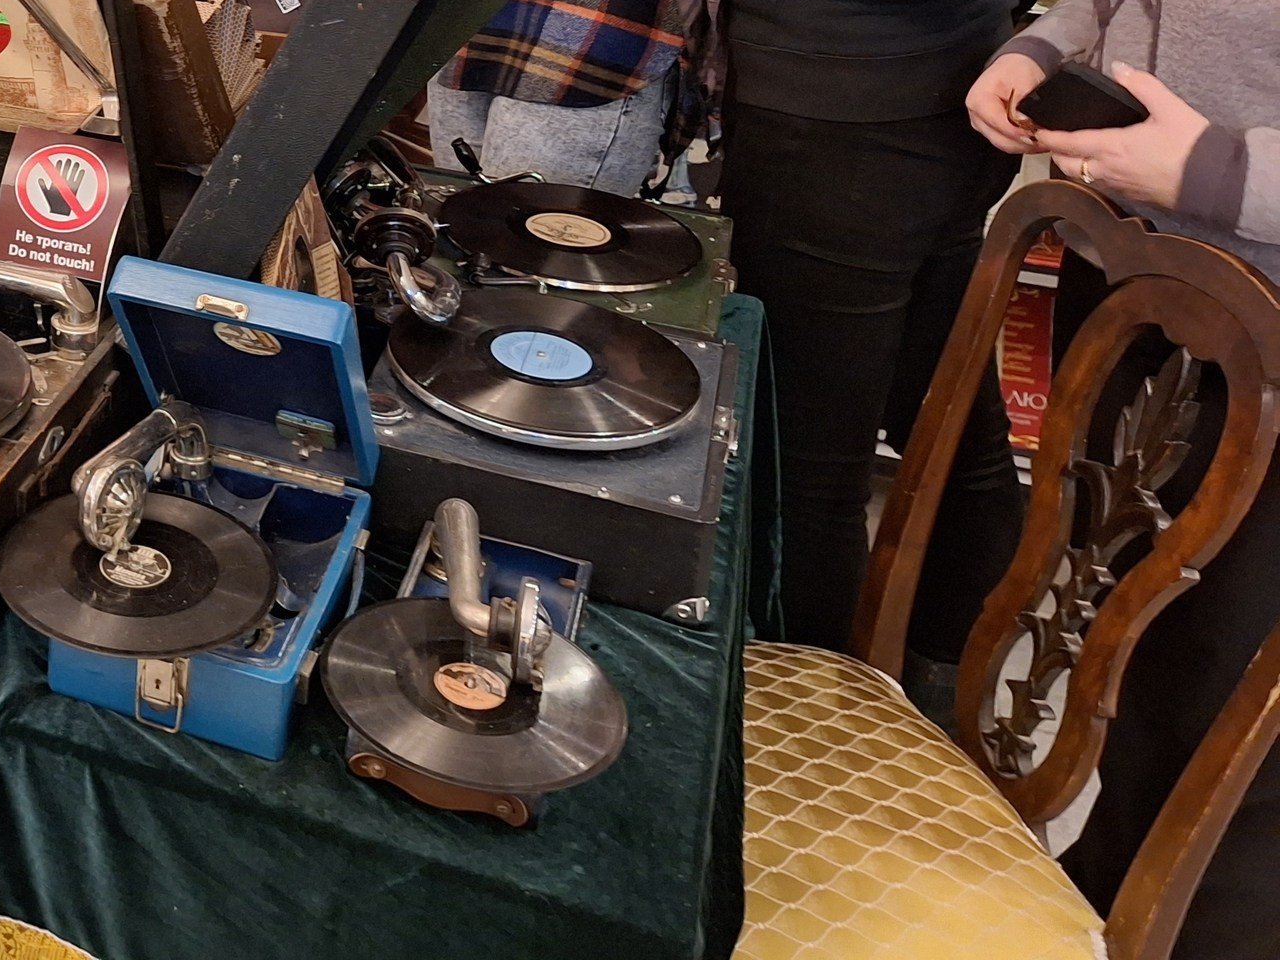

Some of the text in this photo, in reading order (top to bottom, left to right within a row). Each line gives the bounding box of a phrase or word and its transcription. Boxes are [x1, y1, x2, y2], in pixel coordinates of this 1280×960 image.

[16, 229, 91, 255] Не трогать!
[8, 244, 95, 272] Do not touch!
